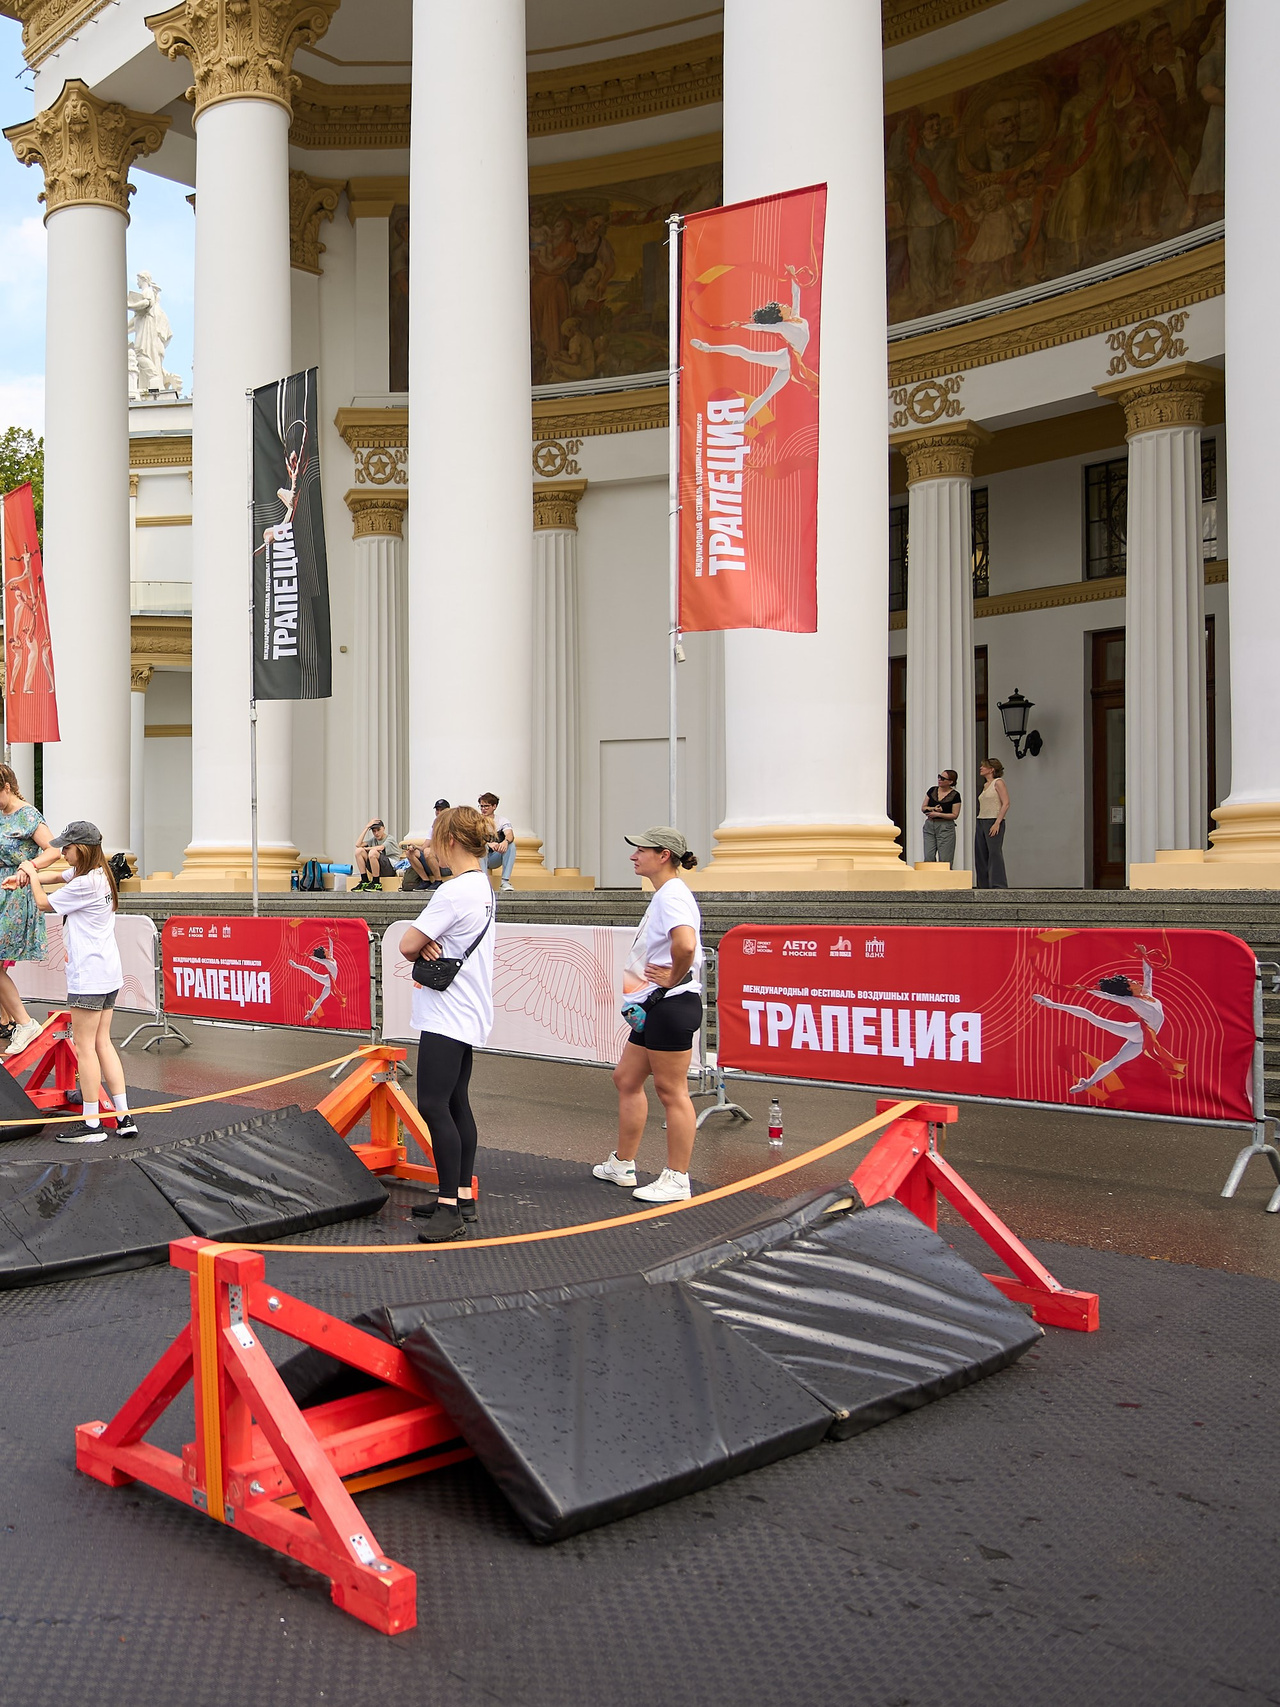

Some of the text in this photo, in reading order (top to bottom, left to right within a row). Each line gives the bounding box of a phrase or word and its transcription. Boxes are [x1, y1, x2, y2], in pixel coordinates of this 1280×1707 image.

[707, 397, 750, 577] ТРАПЕЦИЯ
[273, 522, 299, 660] ТРАПЕЦИЯ
[782, 940, 817, 950] ЛЕТО
[173, 966, 271, 1007] ТРАПЕЦИЯ
[742, 984, 961, 1004] МЕЖДУНАРОДНЫЙ ФЕСТИВАЛЬ ВОЗДУШНЫХ ГИМНАСТОВ
[741, 999, 982, 1067] ТРАПЕЦИЯ
